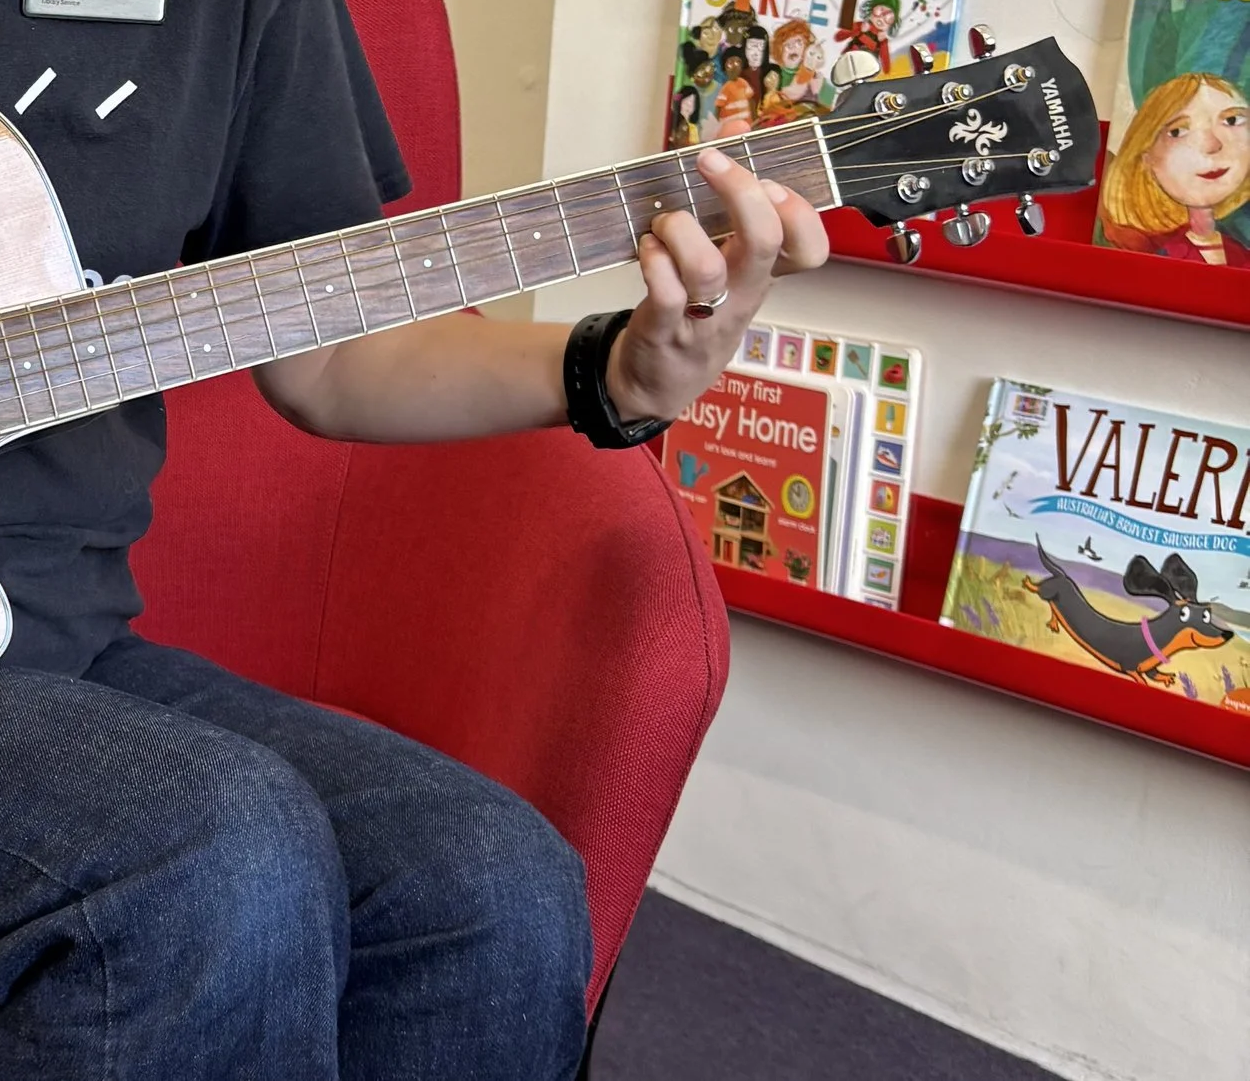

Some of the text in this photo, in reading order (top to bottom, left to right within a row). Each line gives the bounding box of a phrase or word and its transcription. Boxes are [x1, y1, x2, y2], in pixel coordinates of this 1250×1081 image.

[1040, 77, 1075, 153] YAMAHA
[727, 378, 783, 405] my first
[720, 443, 737, 458] look
[737, 448, 754, 462] and
[738, 405, 818, 454] Home
[1054, 403, 1250, 531] VALERI
[1056, 498, 1238, 552] AUSTRALIA'S BRAVEST SAUSAGE DOG
